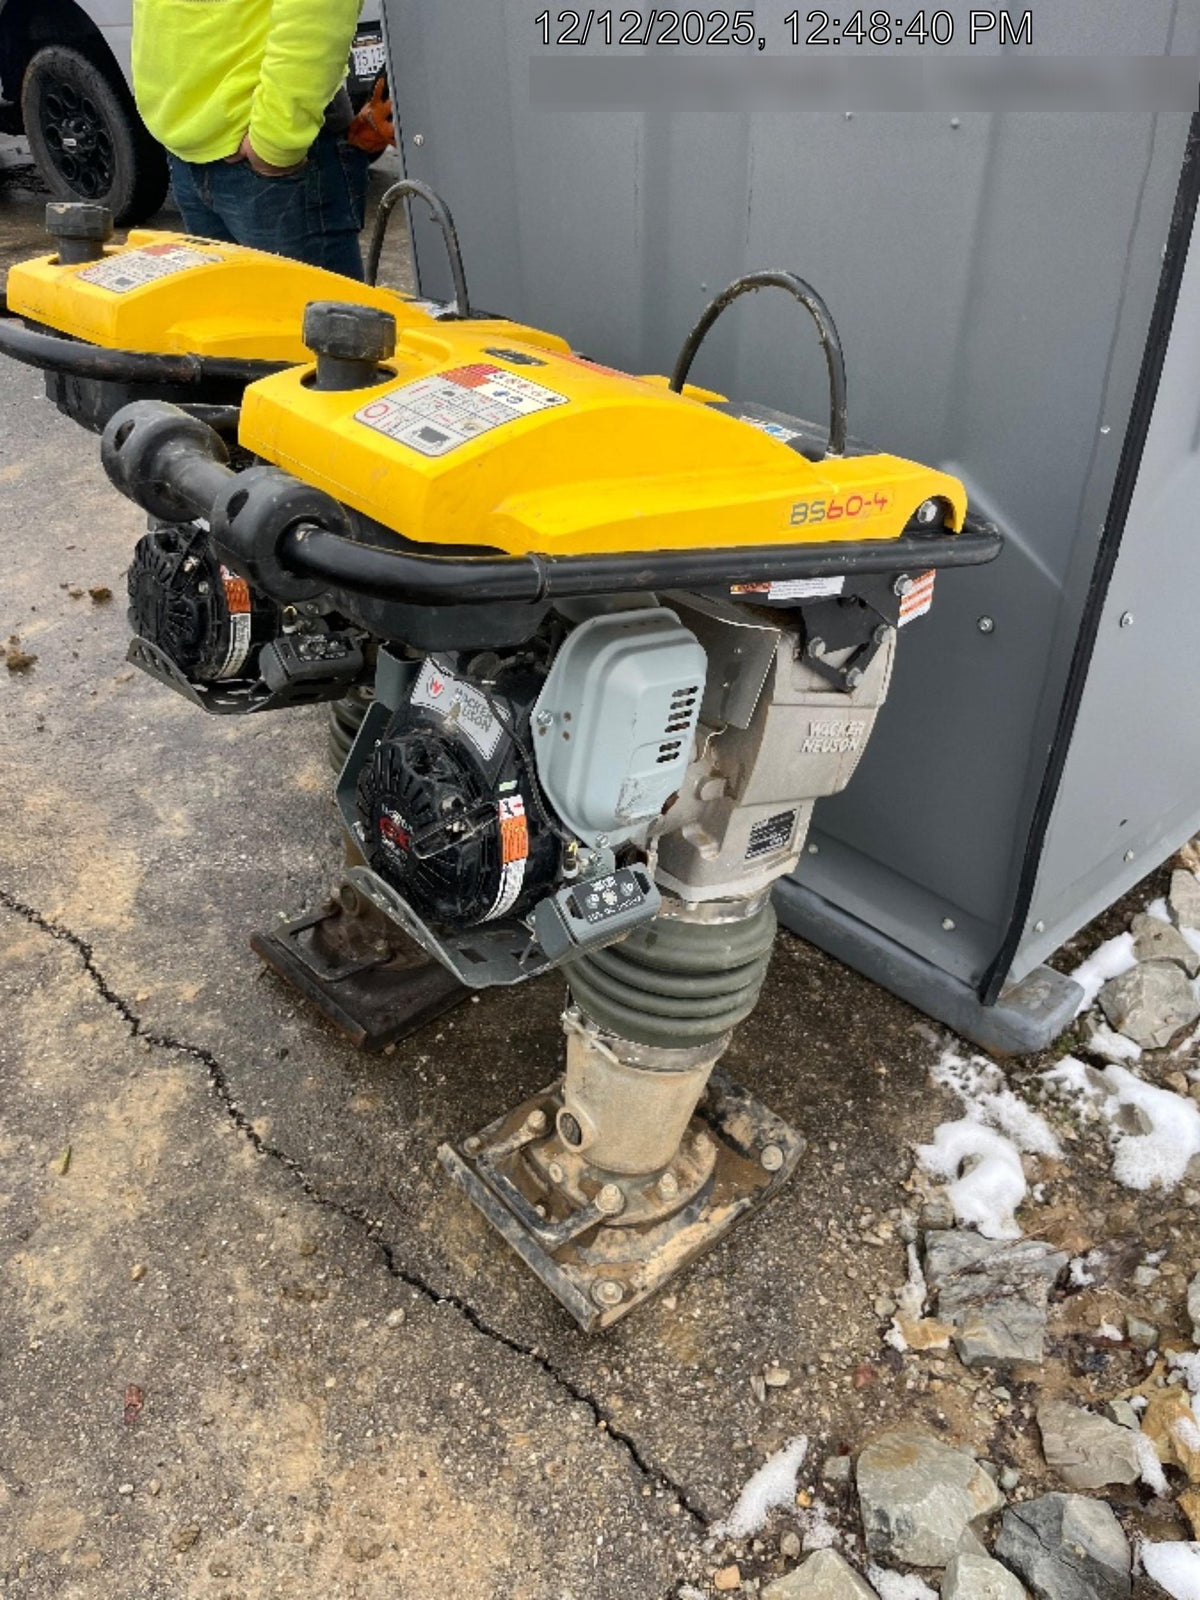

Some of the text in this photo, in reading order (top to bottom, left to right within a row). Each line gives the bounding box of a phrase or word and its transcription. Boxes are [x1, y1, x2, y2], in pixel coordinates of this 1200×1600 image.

[790, 492, 888, 526] BS60-4
[453, 700, 491, 732] USON
[808, 719, 865, 737] WACKER
[800, 738, 860, 753] NEUSON
